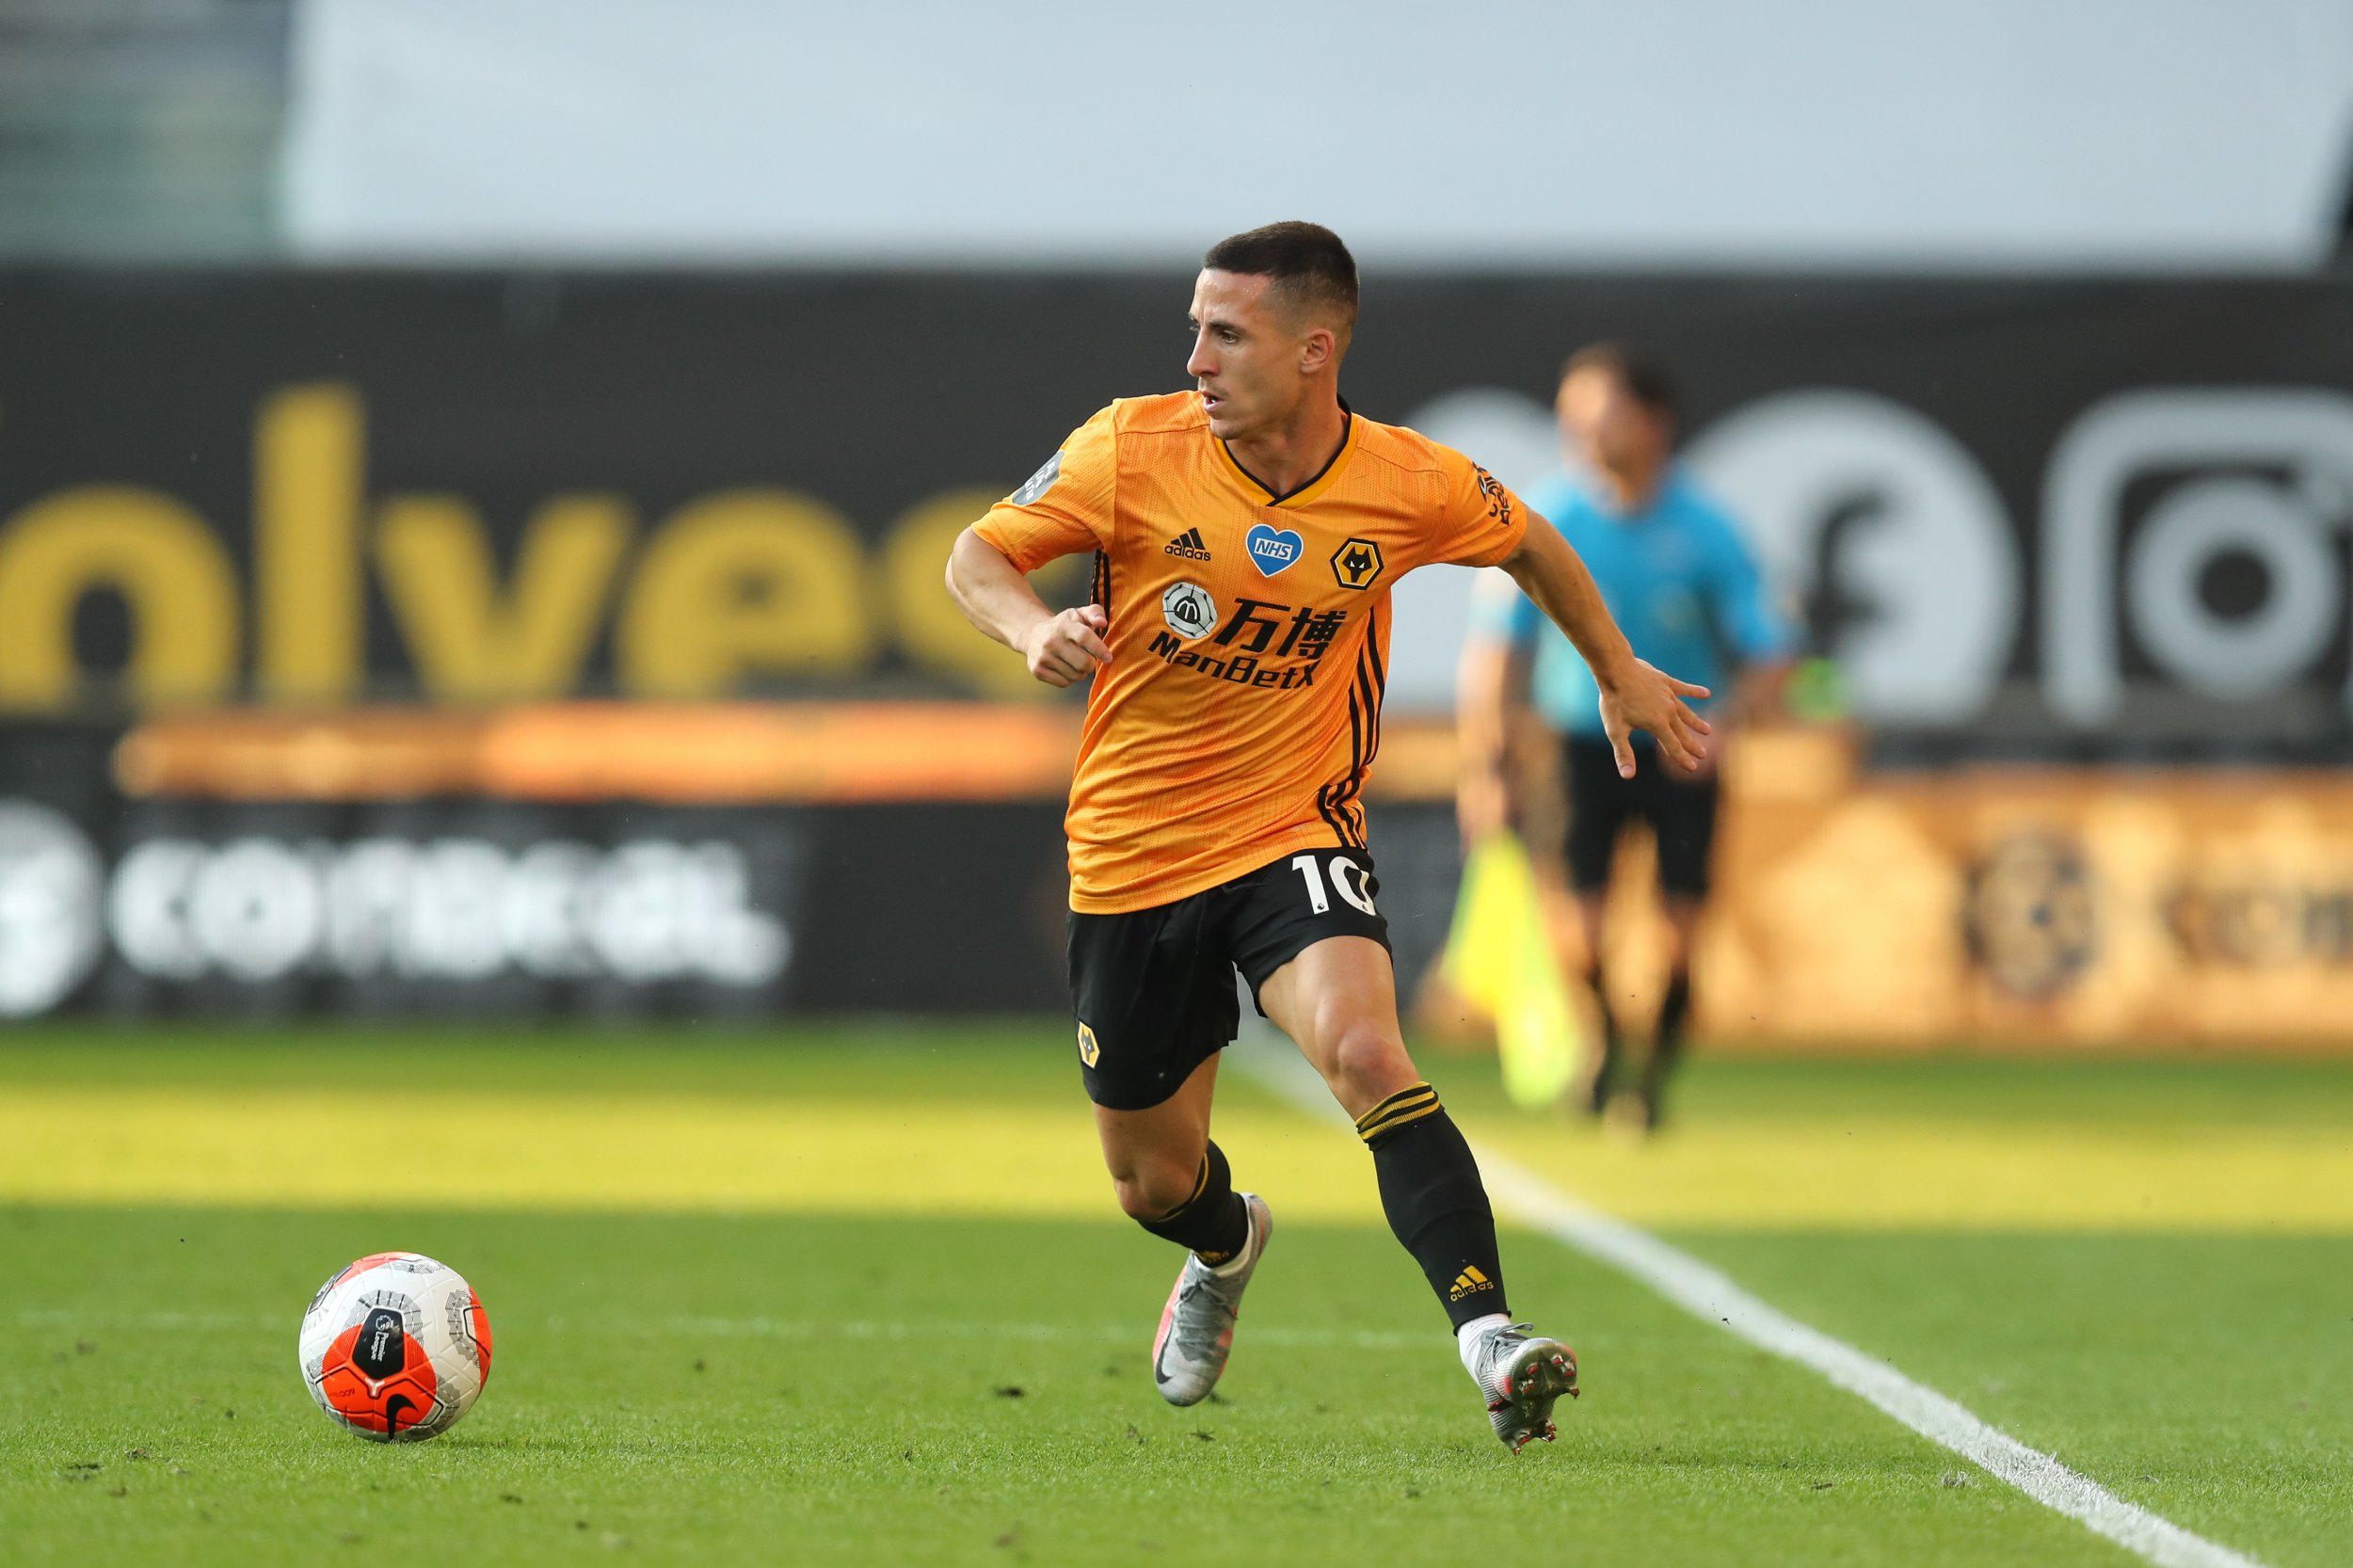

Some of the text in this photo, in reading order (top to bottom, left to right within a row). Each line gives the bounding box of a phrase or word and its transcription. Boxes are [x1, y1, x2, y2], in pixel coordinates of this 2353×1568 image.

[1164, 544, 1211, 562] adidas
[1257, 540, 1292, 559] NHS
[1213, 597, 1347, 661] 万博
[1147, 630, 1321, 690] ManBetX
[1291, 855, 1376, 916] 10
[1450, 1281, 1494, 1302] adidas
[371, 1331, 383, 1361] League
[377, 1332, 390, 1362] Premier
